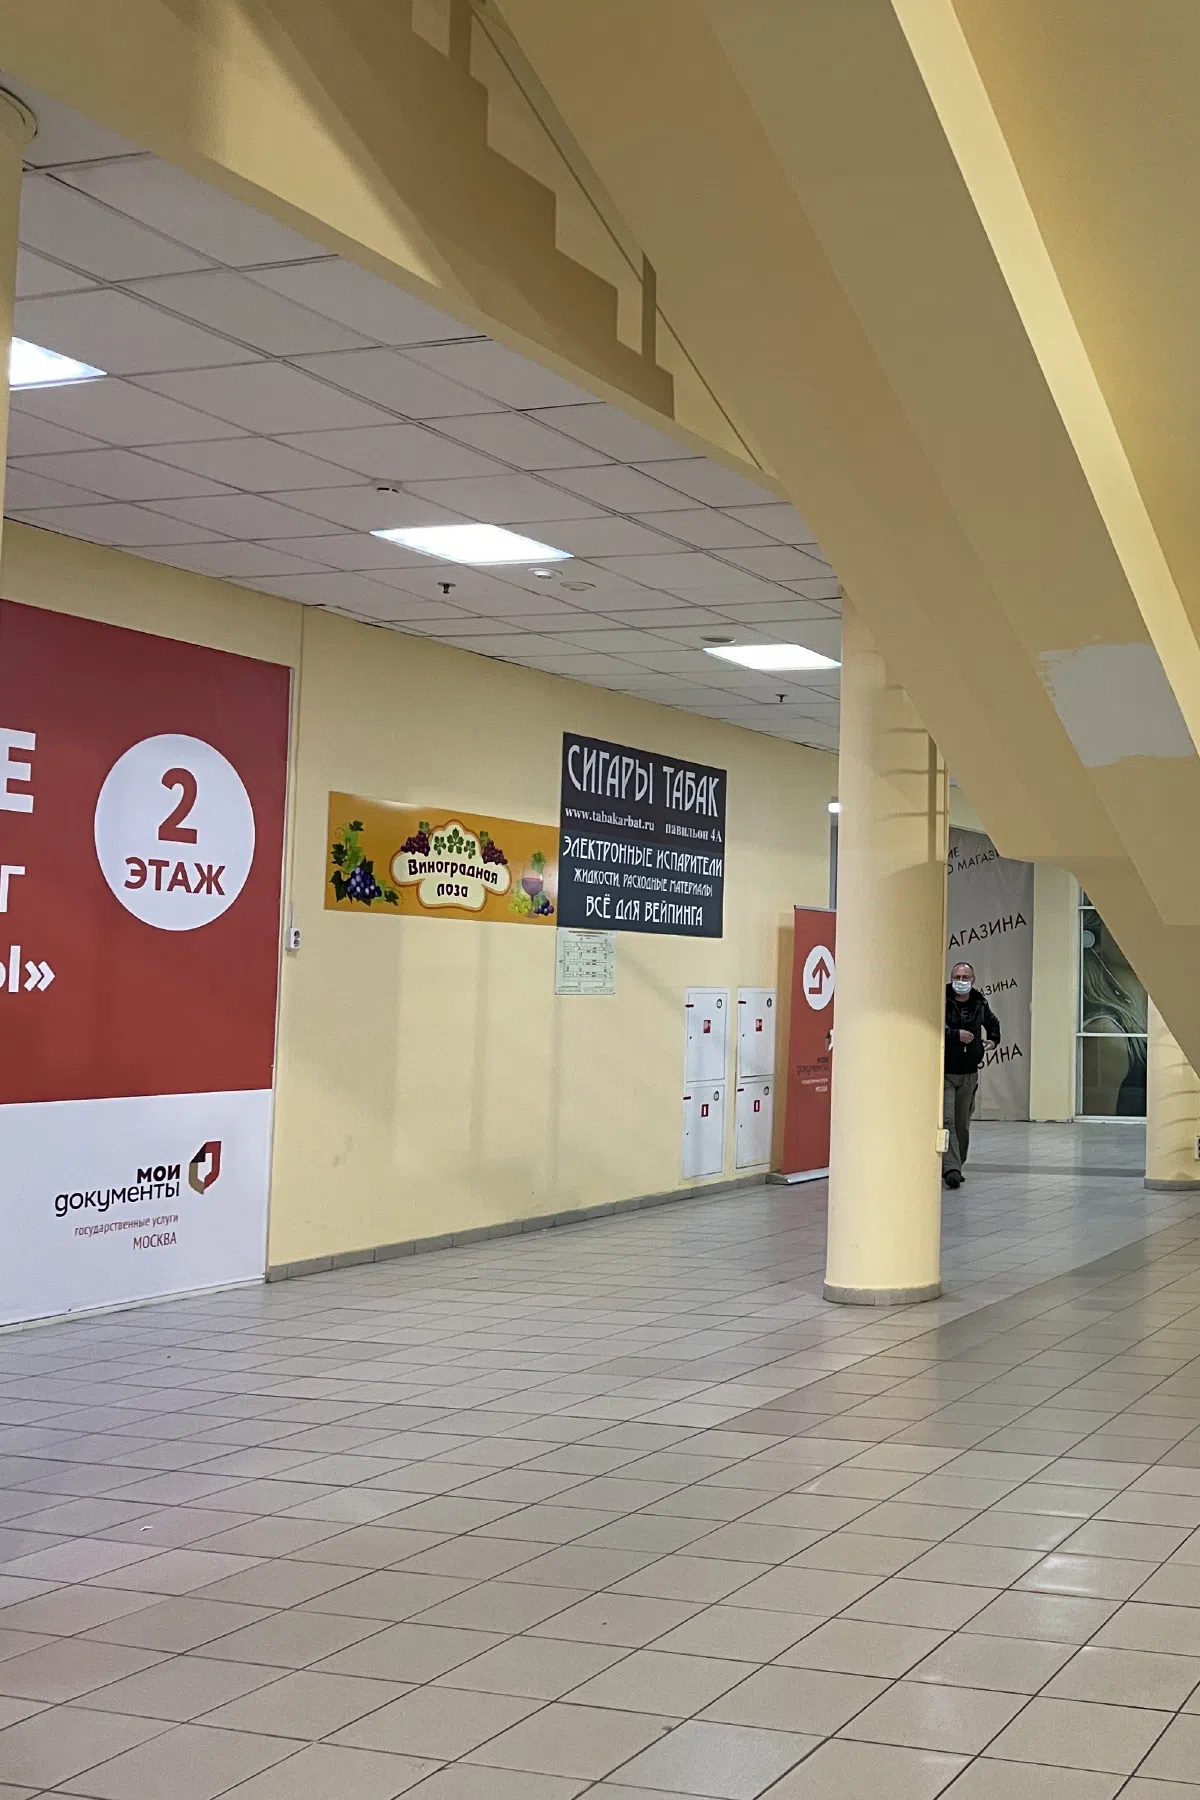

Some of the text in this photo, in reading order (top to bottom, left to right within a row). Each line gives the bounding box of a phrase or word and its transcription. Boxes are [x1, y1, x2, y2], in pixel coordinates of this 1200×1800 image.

[568, 744, 720, 817] СИГАРЫ ТАБАК
[158, 767, 198, 844] 2
[565, 807, 655, 831] www.tabakarbat.ru
[665, 823, 709, 841] павильон
[563, 836, 722, 877] ЭЛЕКТРОННЫЕ ИСПАРИТЕЛИ
[124, 856, 226, 896] ЭТАЖ
[408, 859, 498, 885] Виноградная
[573, 867, 713, 897] ЖИДКОСТИ, РАСХОДНЫЕ МАТЕРИАЛЫ
[436, 883, 468, 898] лоза
[586, 894, 703, 926] ВСЁ ДЛЯ ВЕЙПИНГА
[137, 1164, 181, 1184] мои
[55, 1181, 180, 1217] документы
[74, 1214, 179, 1237] государственные услуги
[133, 1231, 177, 1250] МОСКВА
